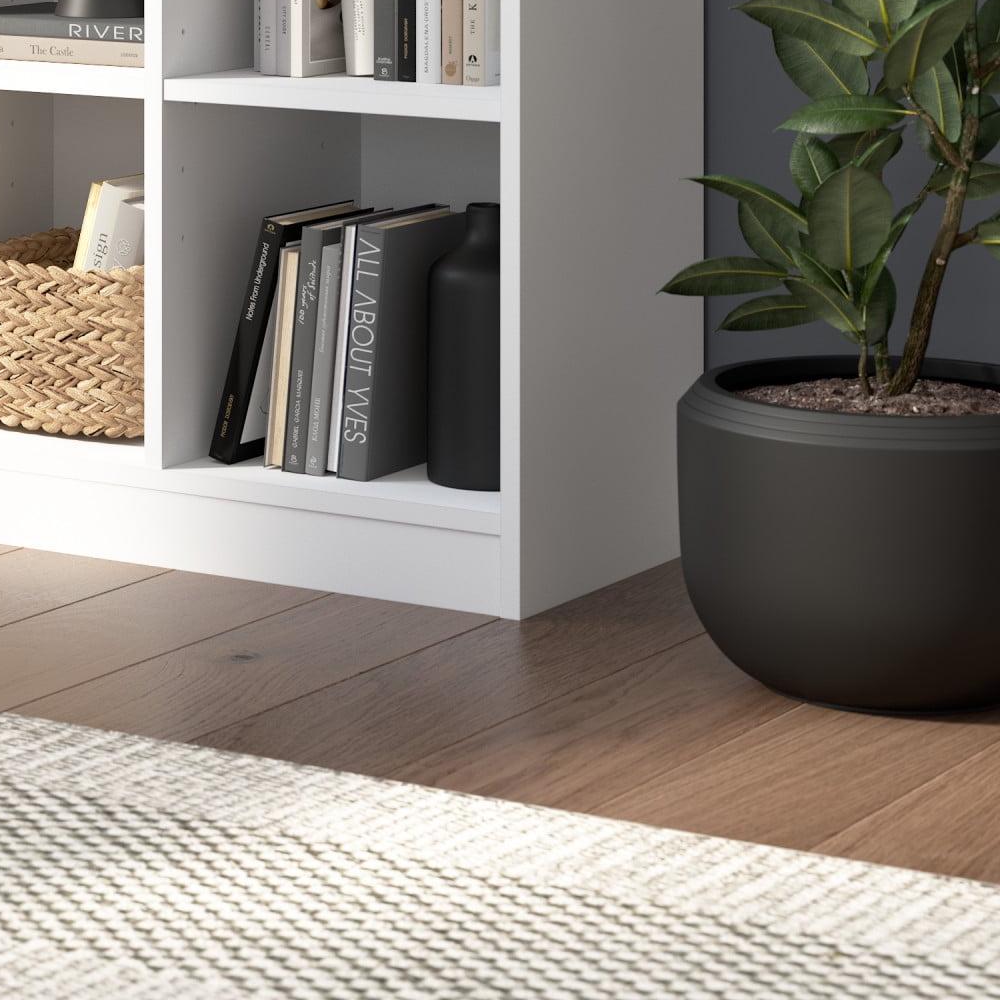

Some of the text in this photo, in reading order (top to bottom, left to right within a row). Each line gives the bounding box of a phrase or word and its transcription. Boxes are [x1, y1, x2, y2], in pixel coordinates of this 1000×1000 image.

[68, 23, 143, 41] RIVER
[30, 44, 74, 57] The Castle
[245, 301, 256, 321] Notes
[343, 237, 381, 444] ALL ABOUT YVES
